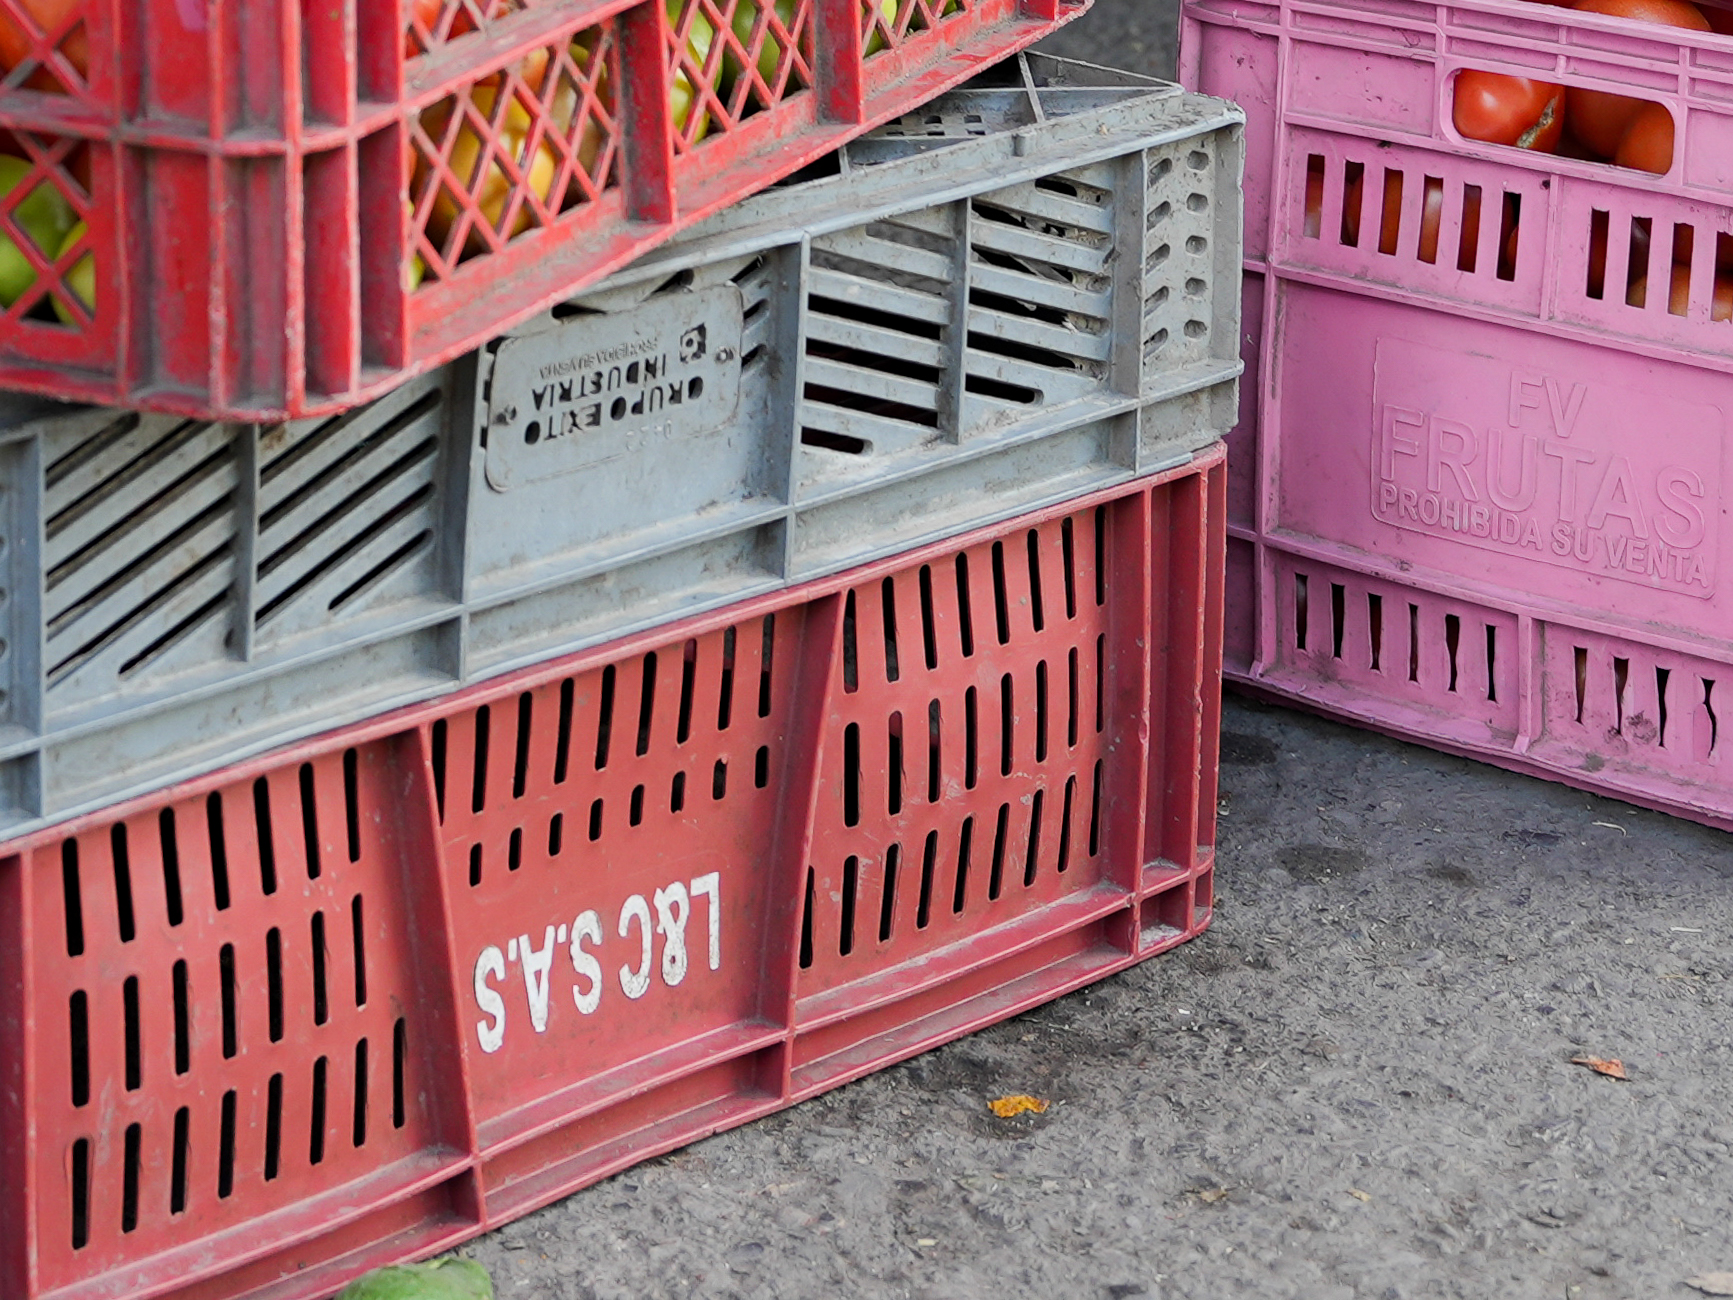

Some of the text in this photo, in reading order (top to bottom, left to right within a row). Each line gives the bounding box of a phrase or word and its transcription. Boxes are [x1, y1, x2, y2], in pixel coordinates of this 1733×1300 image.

[532, 353, 667, 411] INDUSTRIA
[1508, 370, 1587, 439] FV
[1380, 403, 1706, 550] FRUTAS
[1379, 483, 1710, 589] PROHIBIDA SU VENTA
[473, 871, 720, 1054] L&C S.A.S
